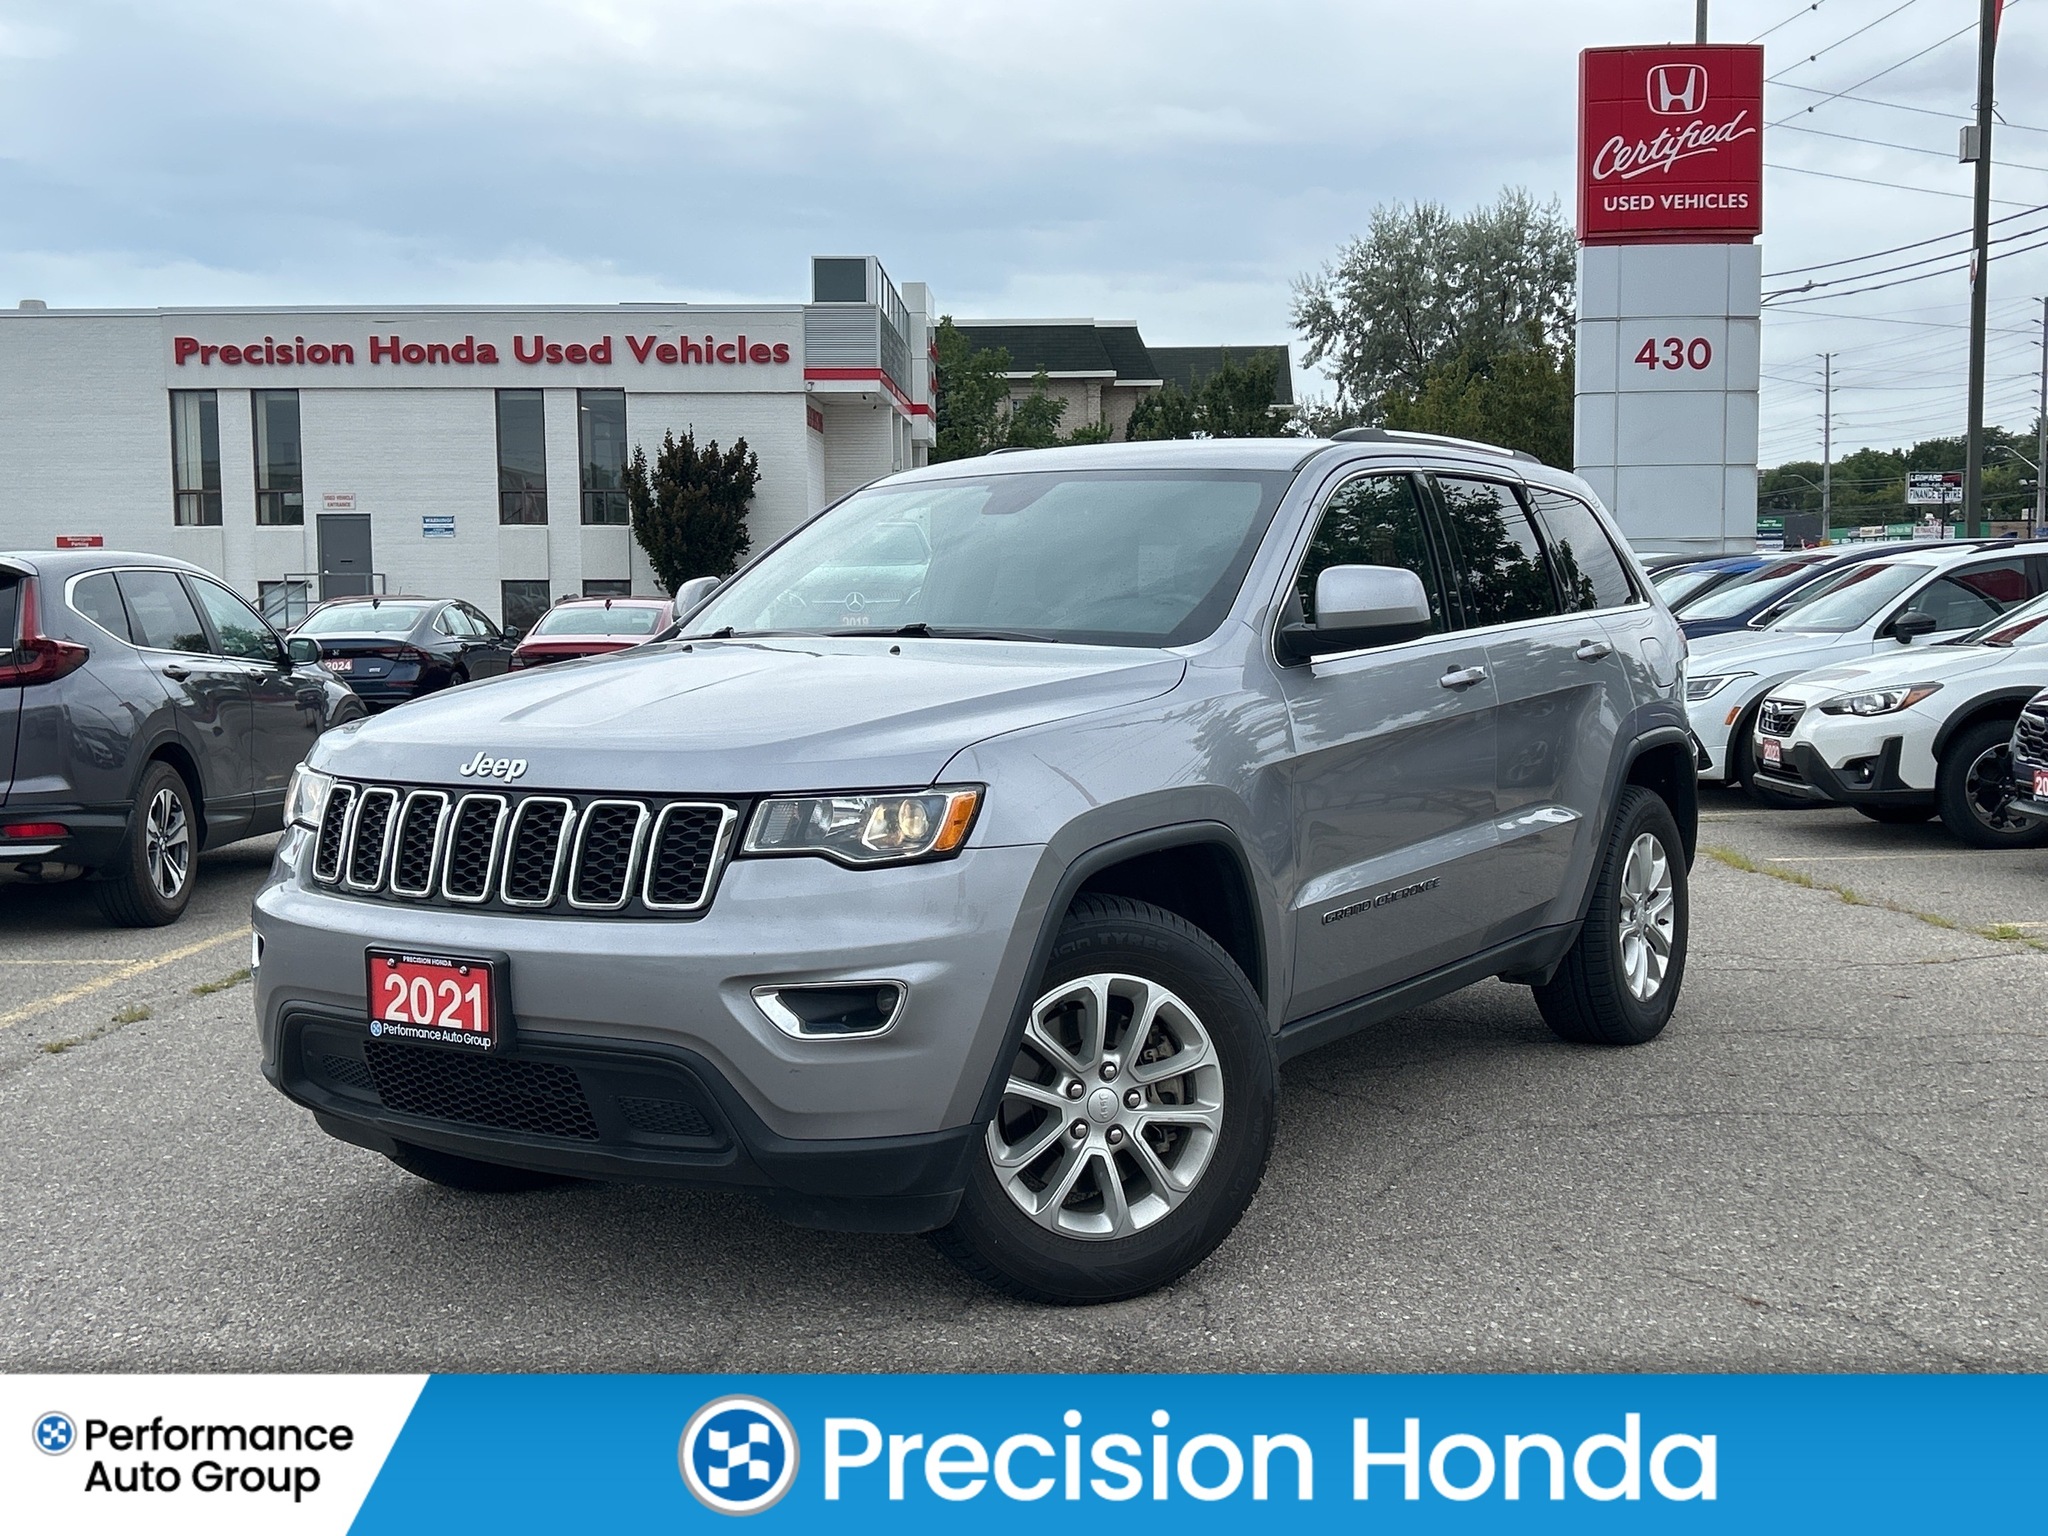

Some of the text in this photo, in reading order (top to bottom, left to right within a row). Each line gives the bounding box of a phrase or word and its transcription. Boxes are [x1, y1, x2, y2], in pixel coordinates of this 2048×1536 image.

[1591, 110, 1756, 181] Certified
[1604, 193, 1749, 212] USED VEHICLES
[174, 335, 790, 366] Precision Honda Used Vehicles
[1634, 337, 1712, 371] 430
[460, 751, 528, 784] Jeep
[1322, 876, 1441, 925] GRAND CHEROKEE
[1097, 931, 1169, 953] TYRES
[402, 955, 453, 967] PRECISION HONDA
[384, 973, 482, 1032] 2021
[383, 1023, 491, 1050] Performance Auto Group
